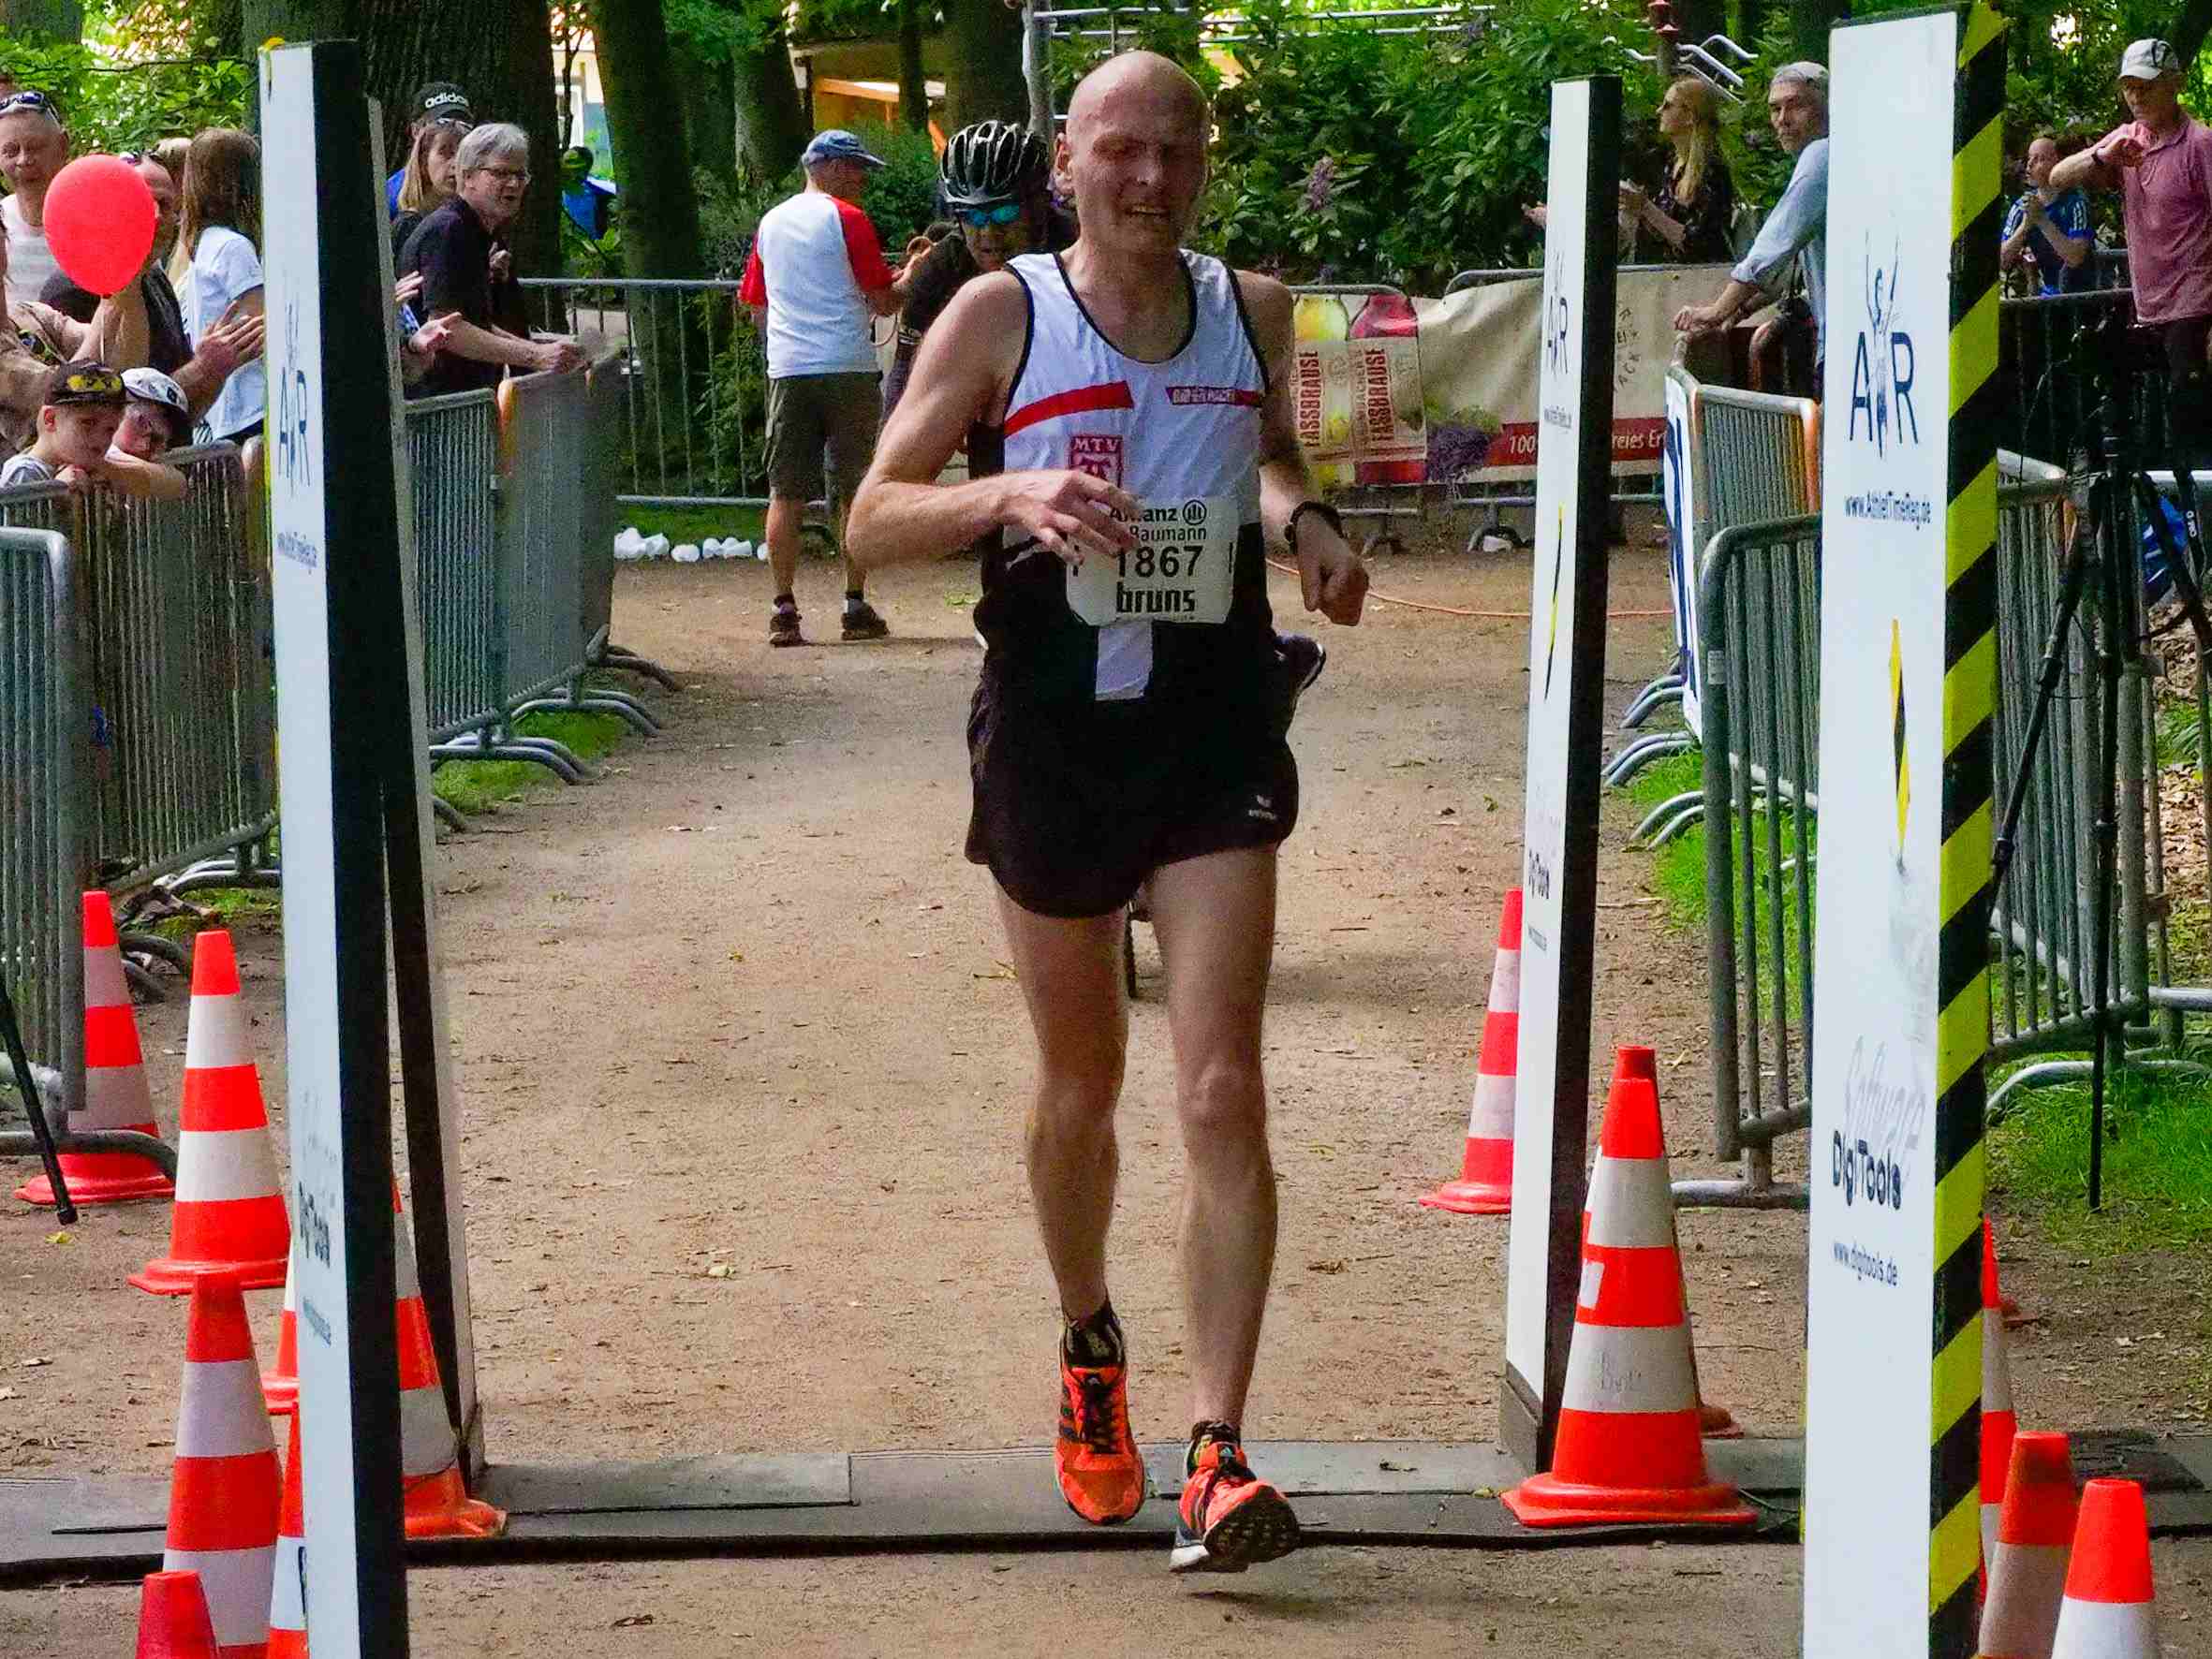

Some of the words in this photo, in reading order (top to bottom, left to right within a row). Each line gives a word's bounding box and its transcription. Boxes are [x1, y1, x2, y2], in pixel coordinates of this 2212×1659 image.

[1299, 350, 1321, 448] FASSBRAUSE
[1364, 348, 1394, 443] FASSBRAUSE
[1071, 437, 1120, 452] MTV
[1116, 545, 1204, 578] 1867
[1116, 580, 1196, 613] bruns
[1832, 1129, 1902, 1211] DigiTools
